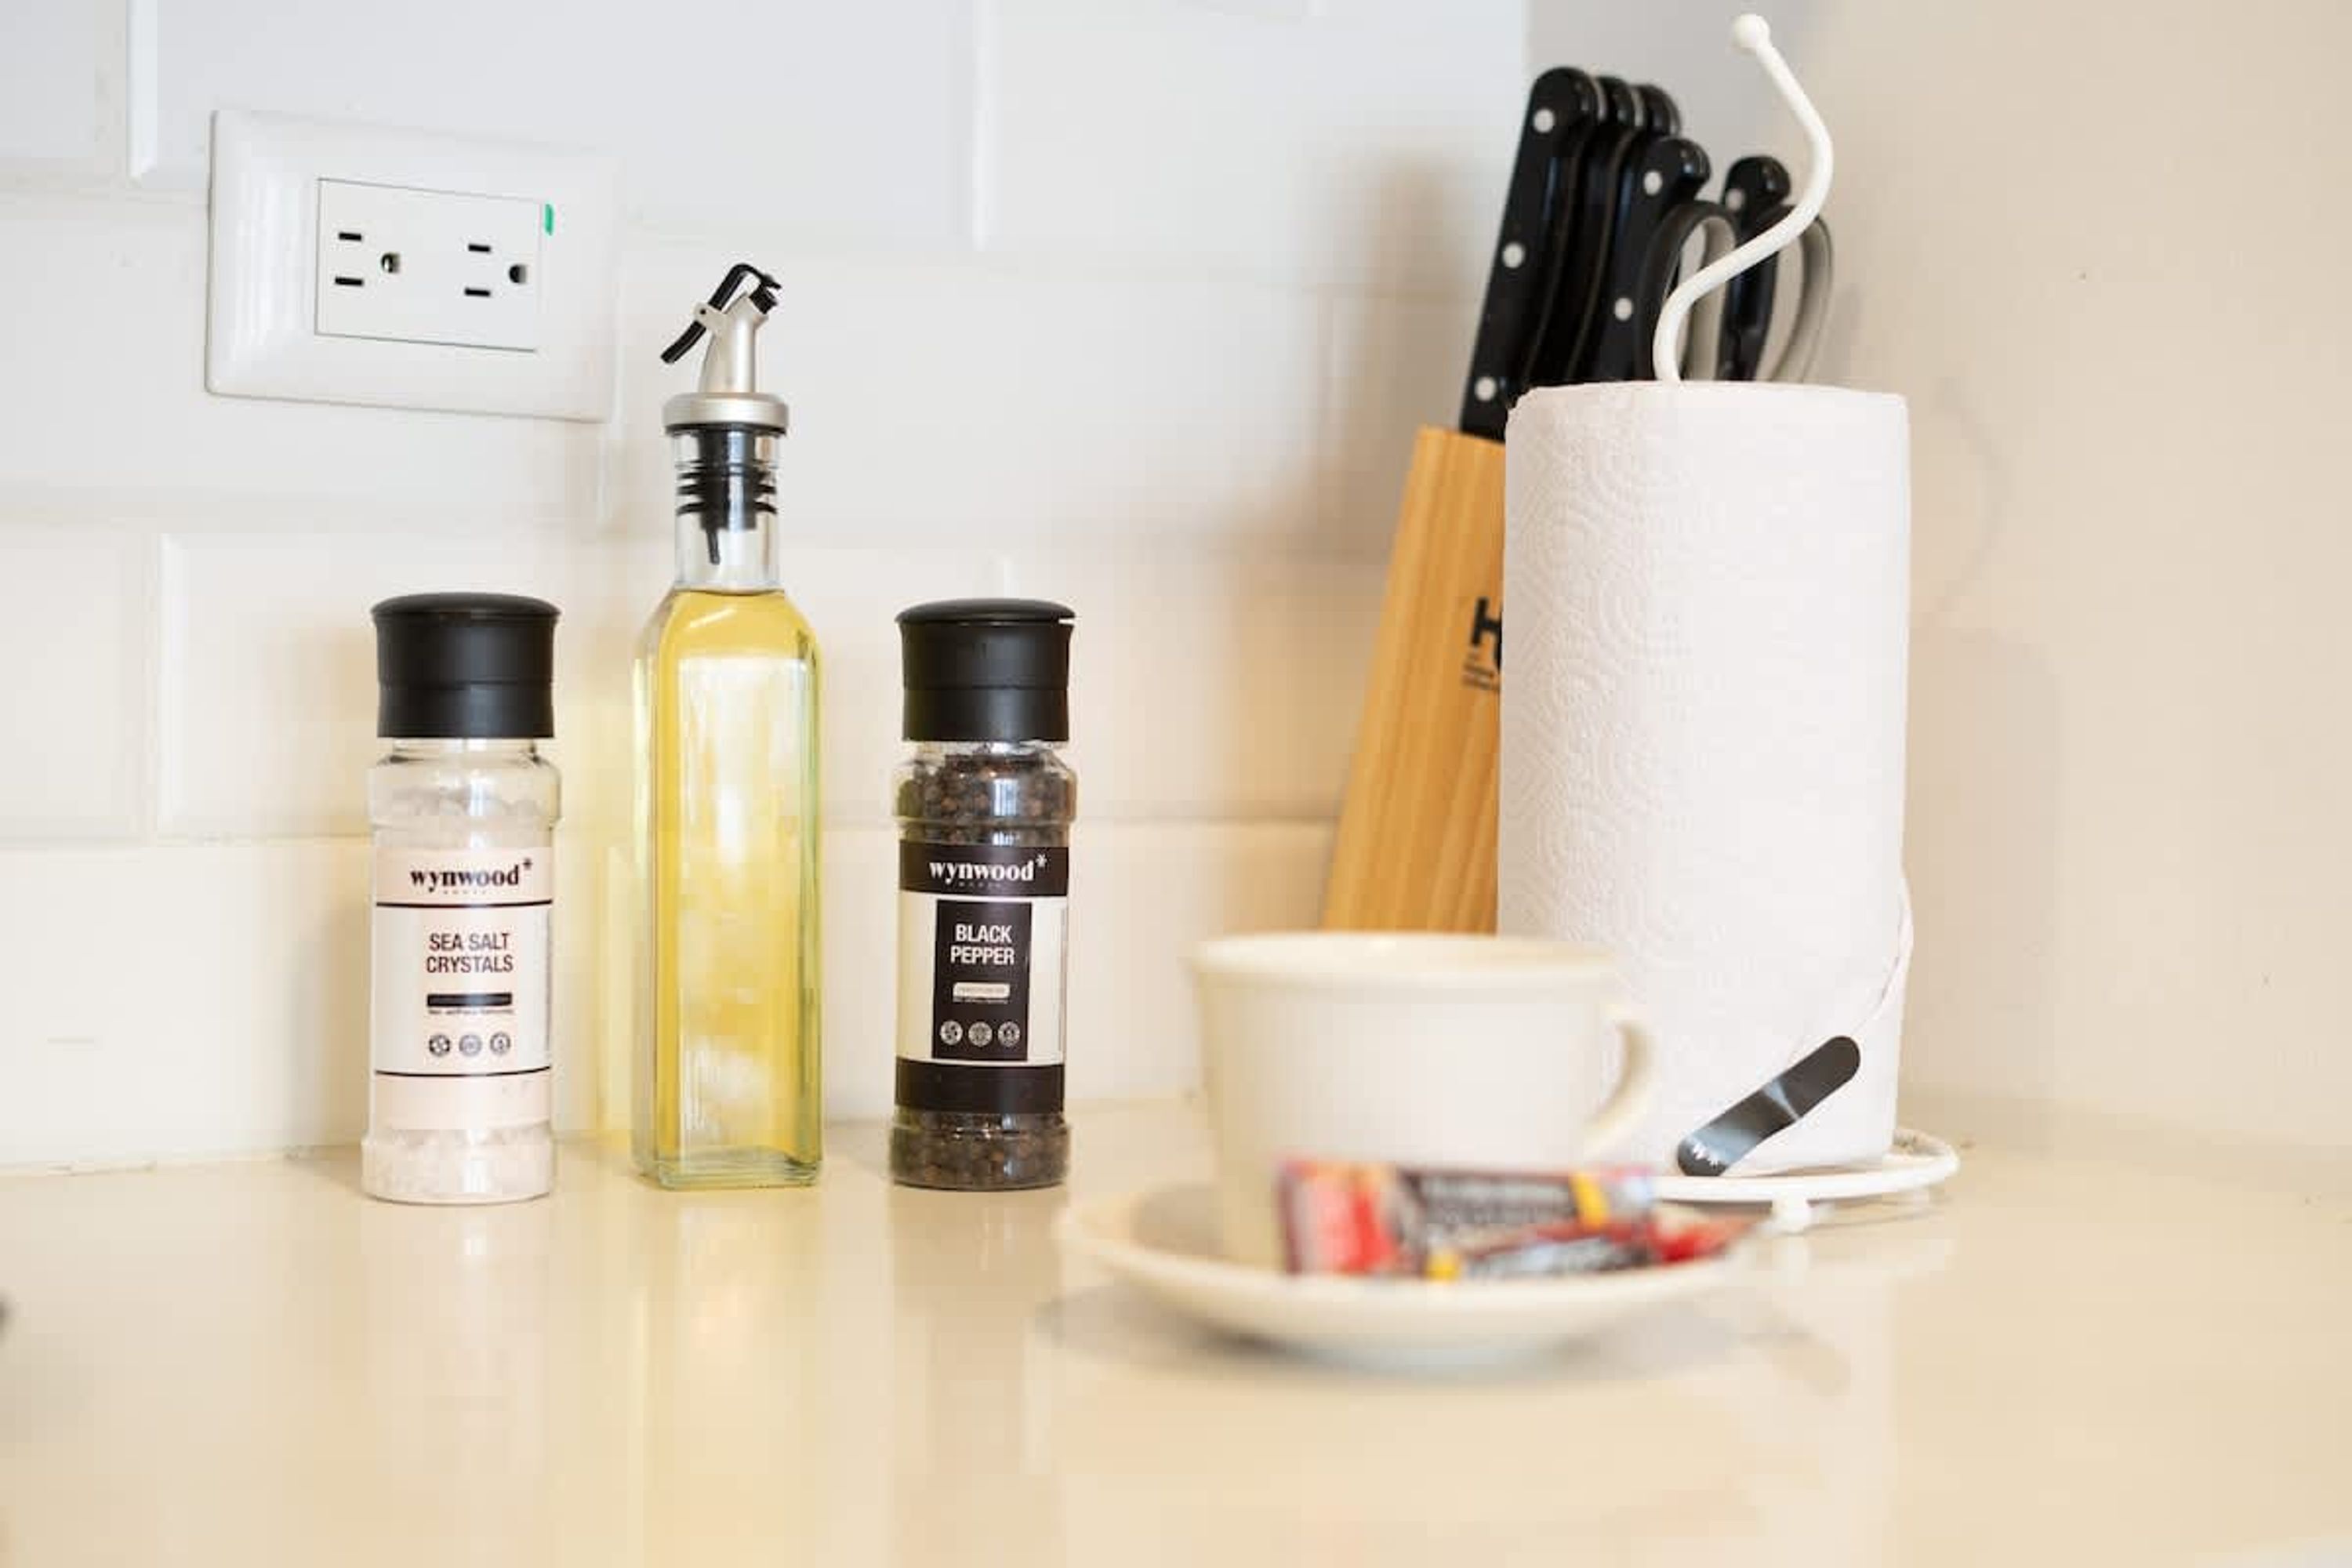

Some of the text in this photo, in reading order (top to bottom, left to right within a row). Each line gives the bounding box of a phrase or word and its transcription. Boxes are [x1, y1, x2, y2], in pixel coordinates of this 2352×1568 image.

[430, 933, 510, 951] SEA SALT
[955, 924, 1012, 943] BLACK
[426, 954, 514, 973] CRYSTALS
[950, 946, 1014, 965] PEPPER
